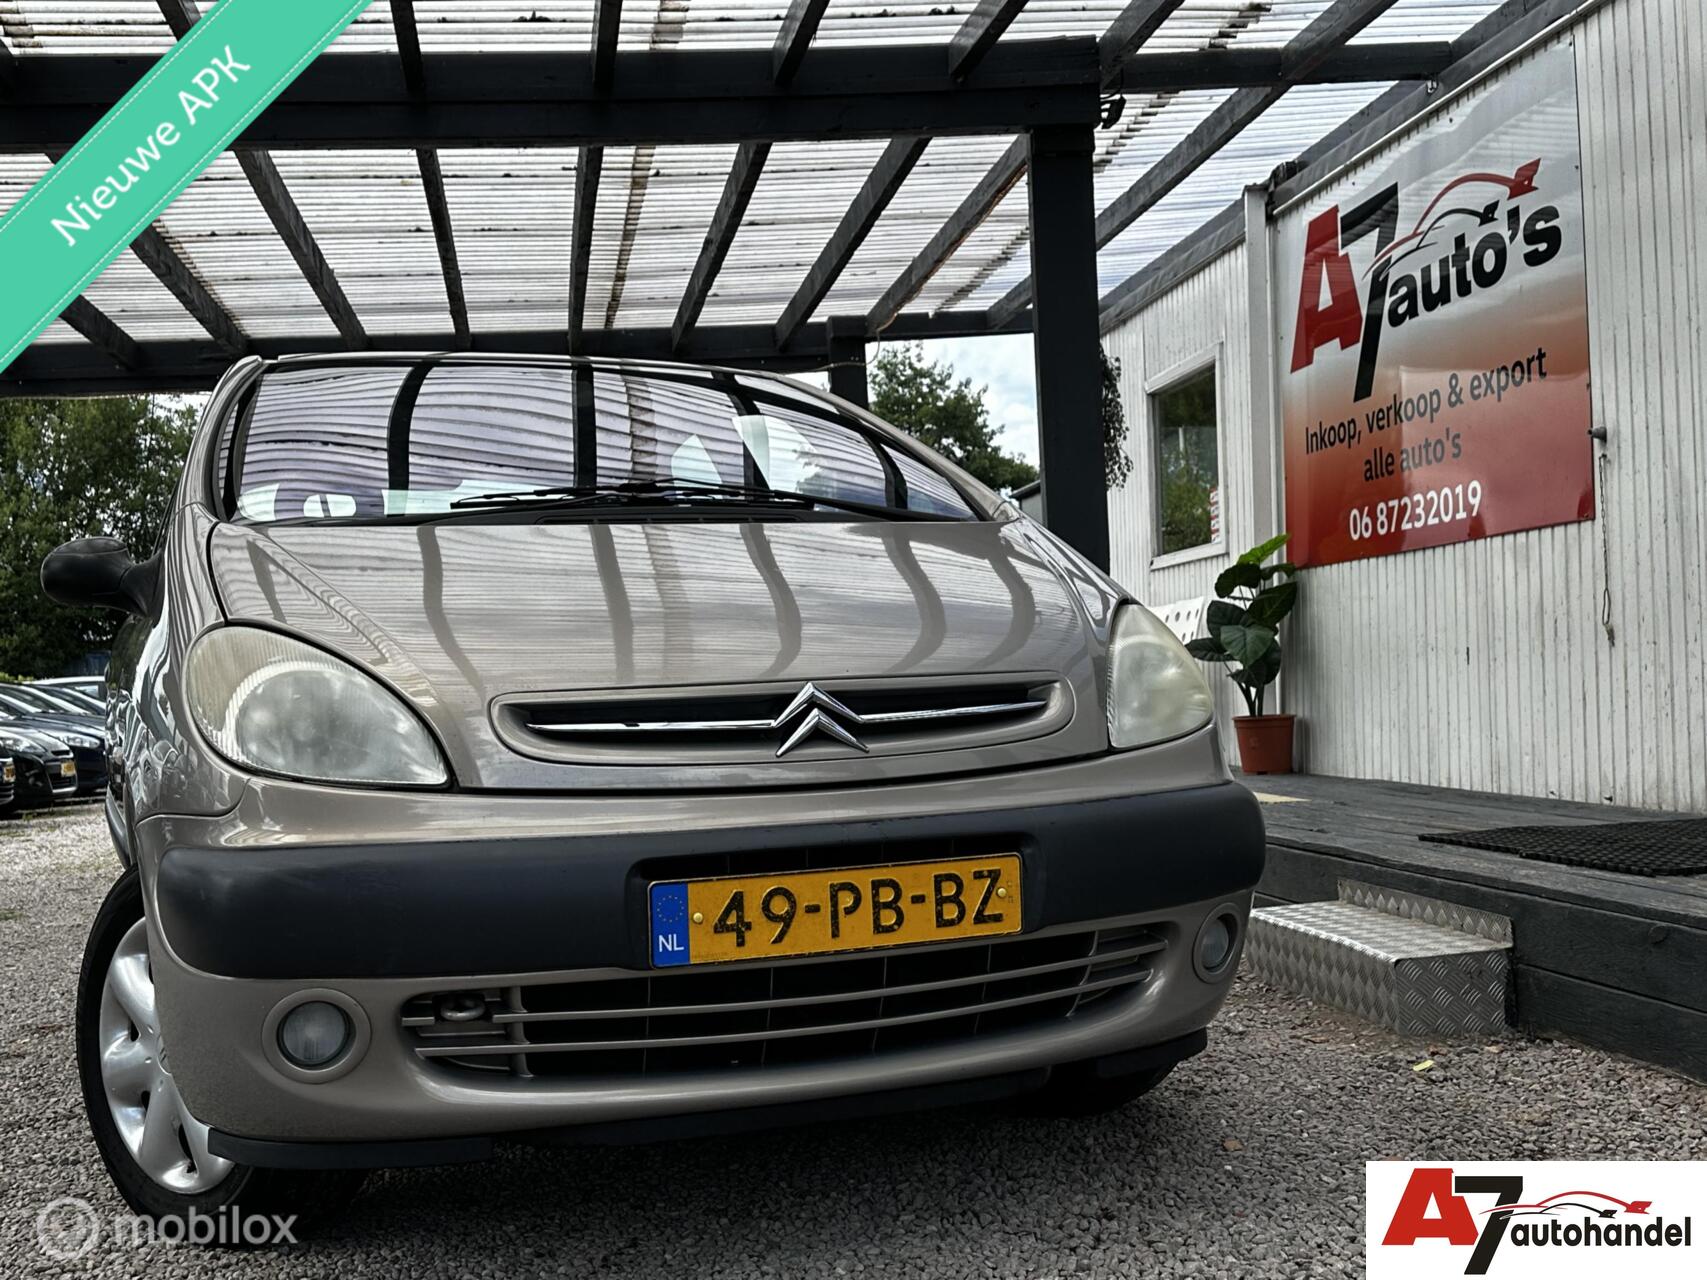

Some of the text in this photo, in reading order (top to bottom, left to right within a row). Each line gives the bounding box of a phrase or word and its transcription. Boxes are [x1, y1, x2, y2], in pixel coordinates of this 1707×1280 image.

[1388, 204, 1562, 328] auto's
[1305, 347, 1547, 455] Inkoop, verkoop & export
[1363, 427, 1462, 482] alle auto's
[1349, 480, 1482, 541] 06 87232019
[713, 868, 1005, 948] 49-PB-BZ
[658, 934, 684, 953] NL
